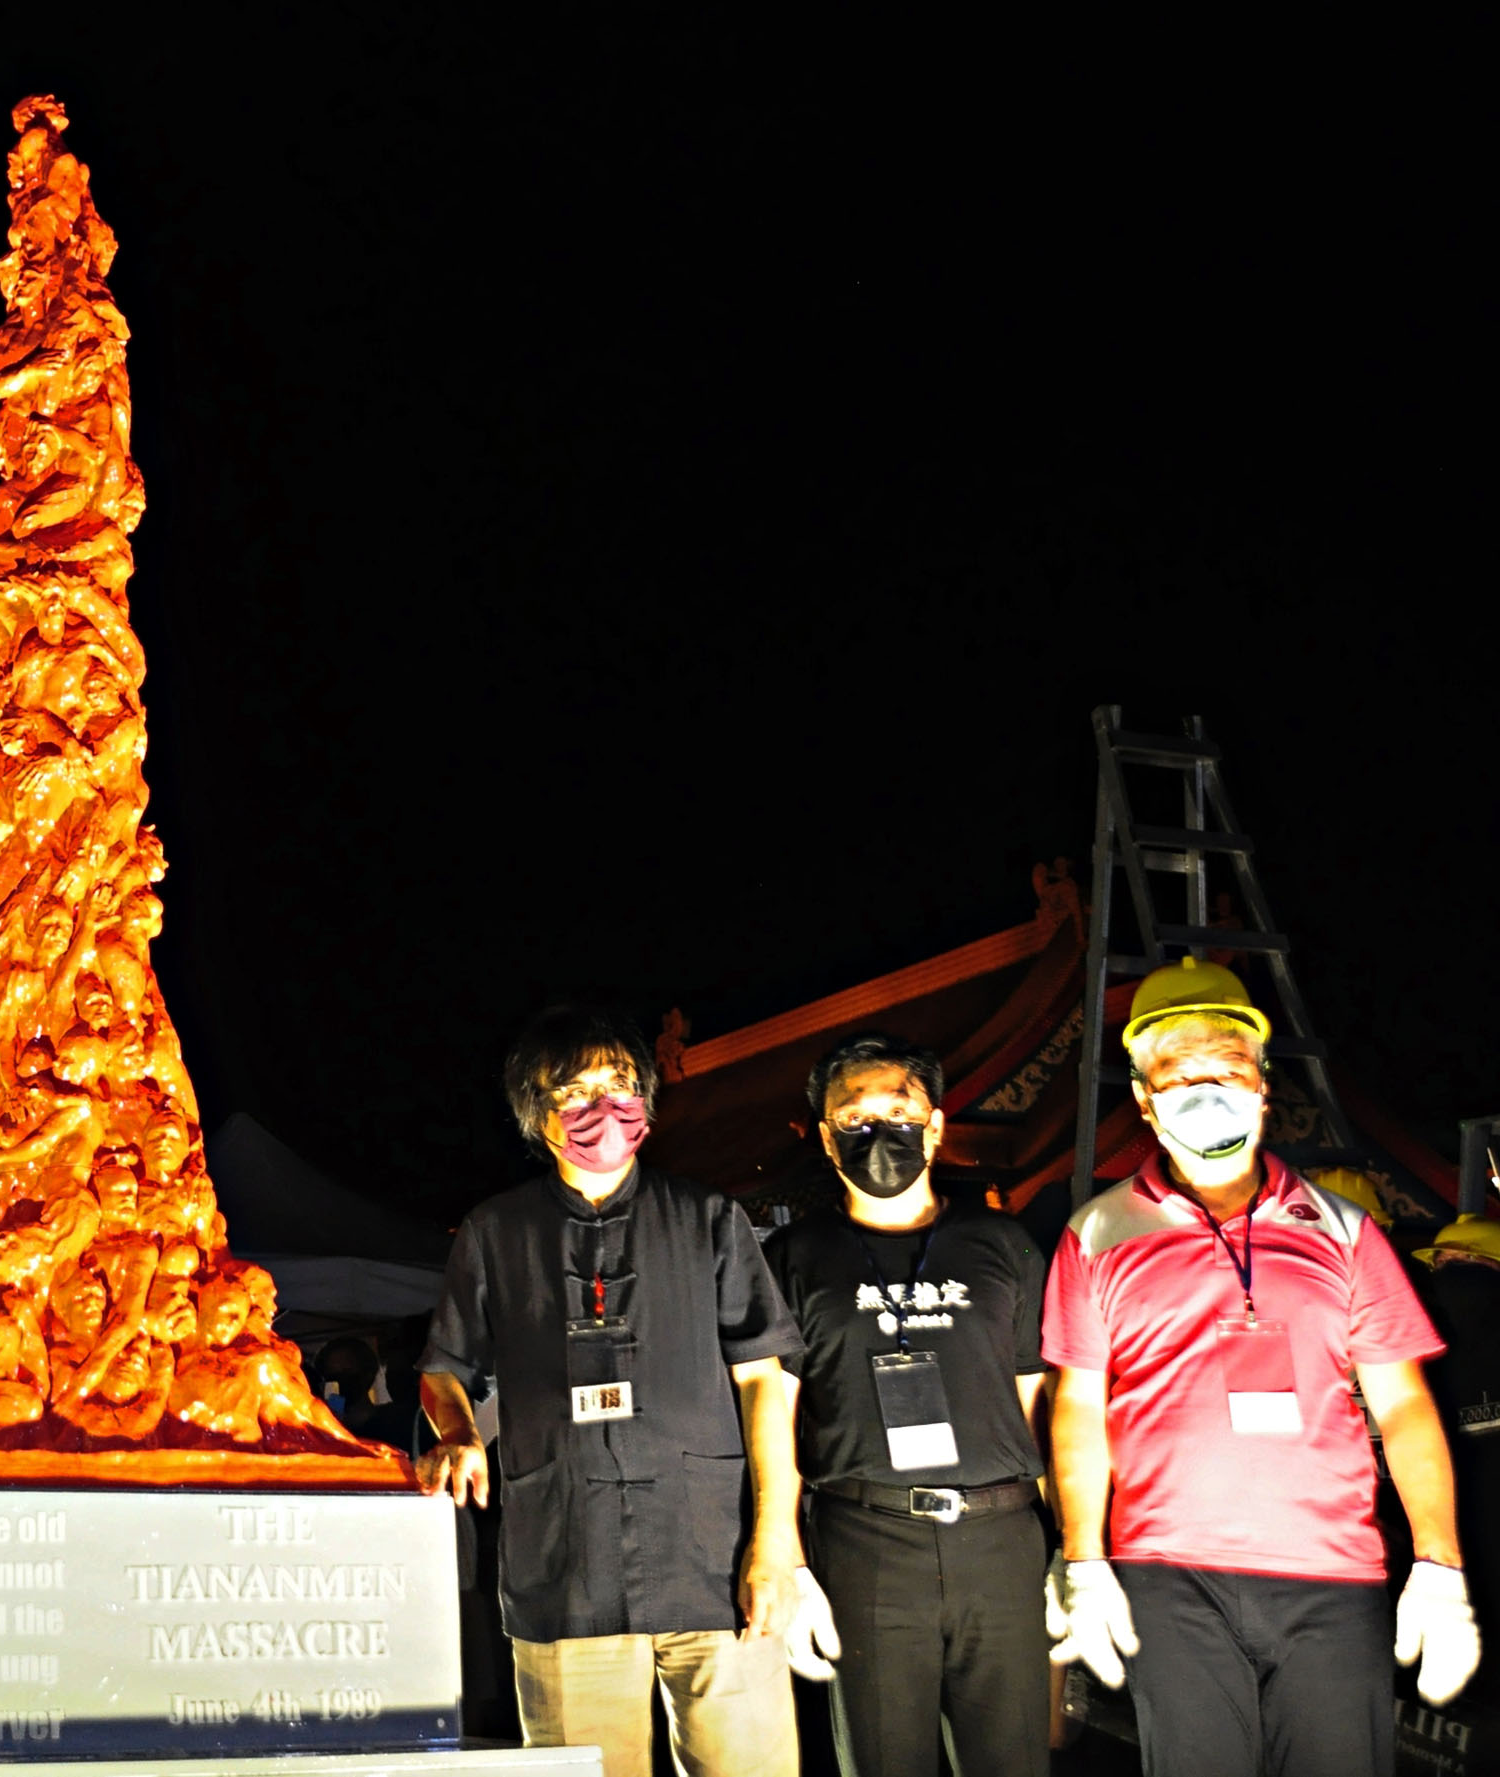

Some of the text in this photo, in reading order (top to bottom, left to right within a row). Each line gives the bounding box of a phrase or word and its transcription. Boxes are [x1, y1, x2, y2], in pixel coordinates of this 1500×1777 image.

[18, 1510, 67, 1544] old
[218, 1504, 317, 1546] THE
[124, 1562, 407, 1602] TIANANMEN
[14, 1602, 65, 1636] the
[147, 1618, 392, 1663] MASSACRE
[167, 1687, 384, 1726] June 4th 1989
